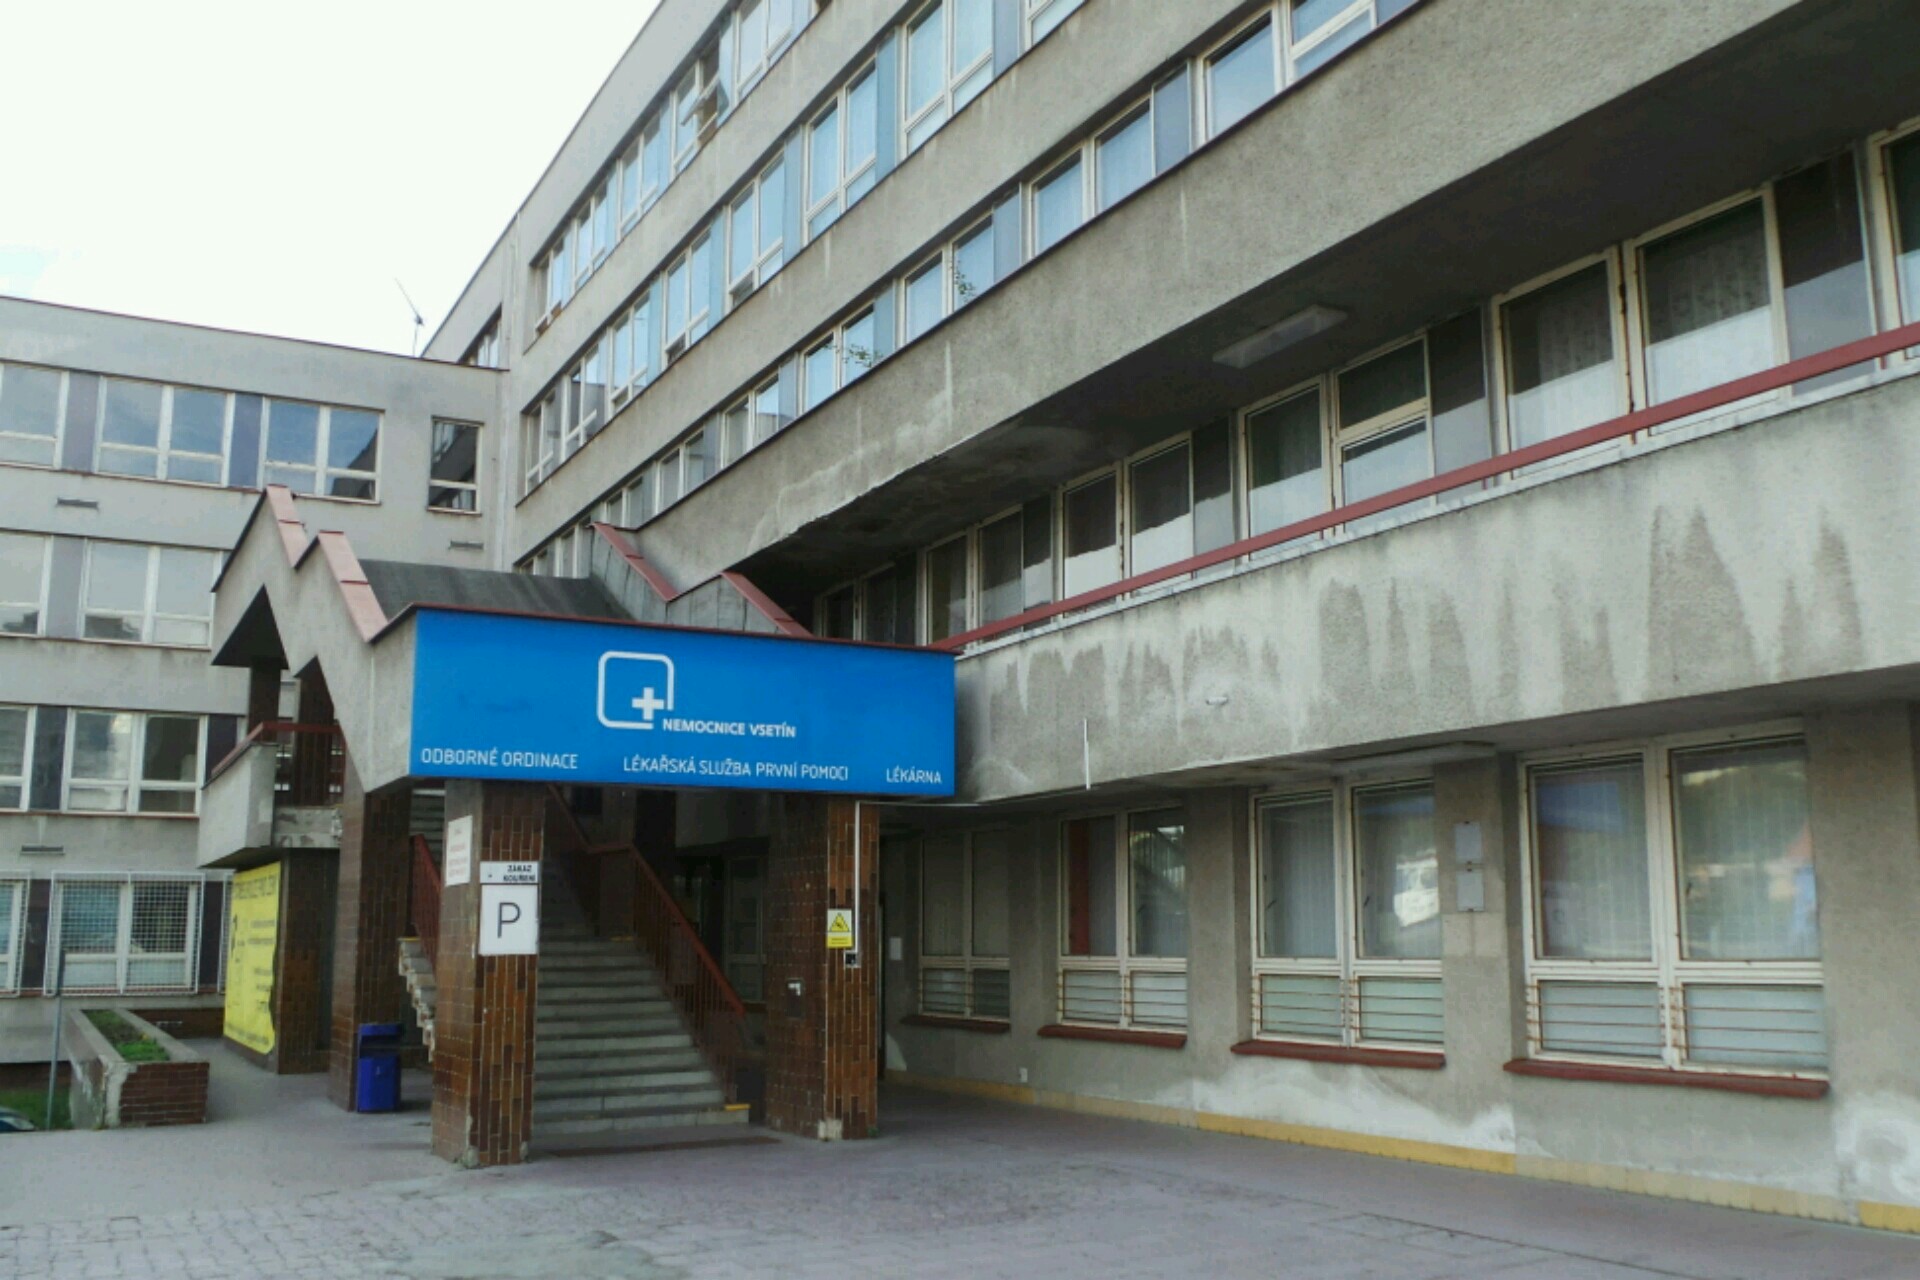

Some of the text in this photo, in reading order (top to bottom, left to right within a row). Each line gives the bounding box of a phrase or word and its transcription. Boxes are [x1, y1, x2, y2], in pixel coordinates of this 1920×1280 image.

[663, 718, 797, 738] NEMOCNICE VSETÍN
[421, 747, 579, 769] ODBORNÉ ORDINACE
[623, 754, 849, 781] LÉKAŘSKÁ SLUŽBA PRVNÍ POMOCI
[886, 765, 943, 784] LÉKÁRNA
[497, 902, 521, 939] P
